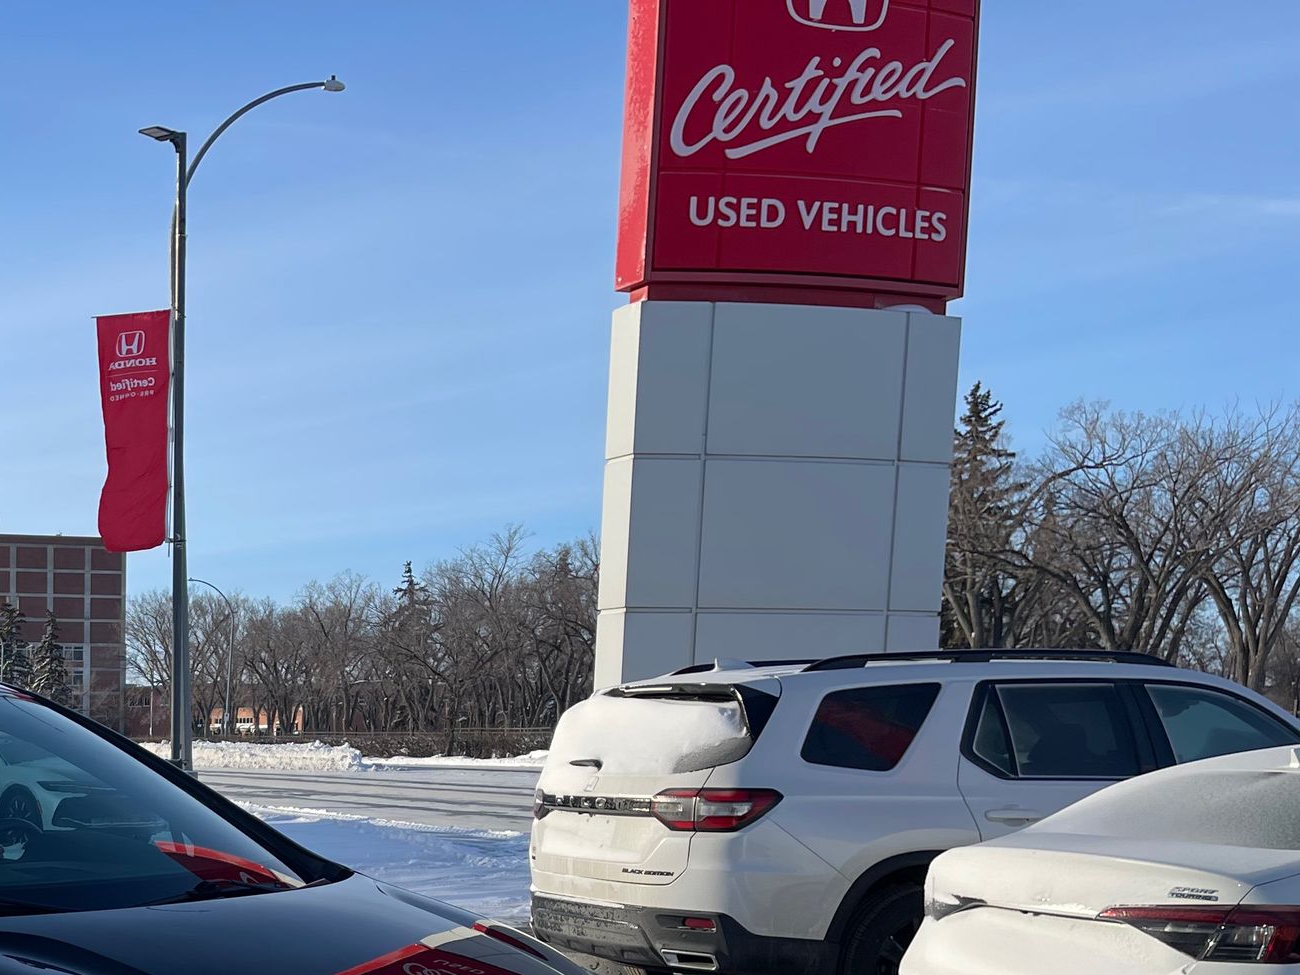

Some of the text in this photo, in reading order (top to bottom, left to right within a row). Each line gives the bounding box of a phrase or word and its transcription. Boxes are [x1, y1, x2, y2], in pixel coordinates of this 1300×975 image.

[669, 38, 966, 159] Certified
[689, 195, 948, 242] USED VEHICLES
[621, 867, 643, 875] BLACK
[1169, 892, 1218, 901] TOURING
